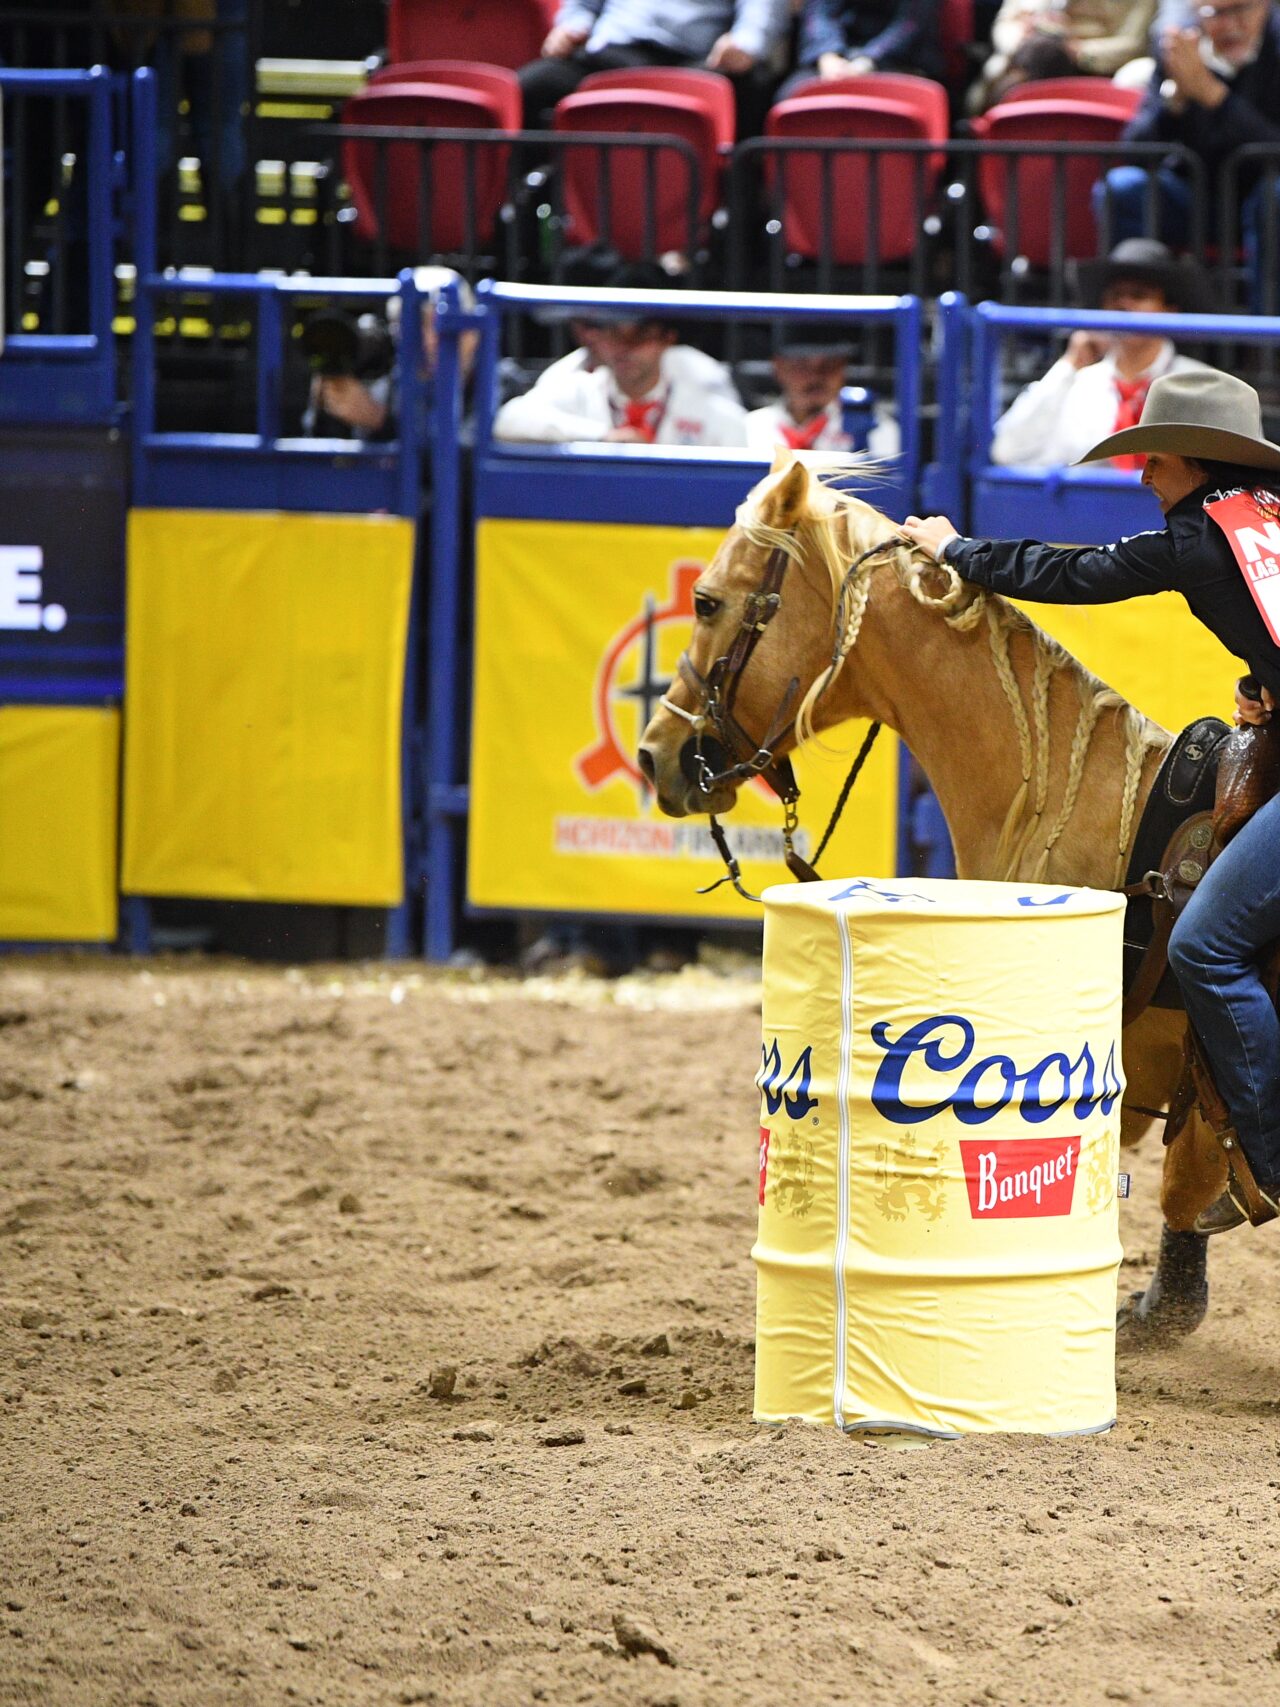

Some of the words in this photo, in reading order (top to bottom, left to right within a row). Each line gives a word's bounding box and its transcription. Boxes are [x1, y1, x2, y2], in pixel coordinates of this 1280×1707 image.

[1246, 557, 1280, 582] LAS
[870, 1014, 1123, 1125] Coors
[976, 1146, 1076, 1212] Banquet
